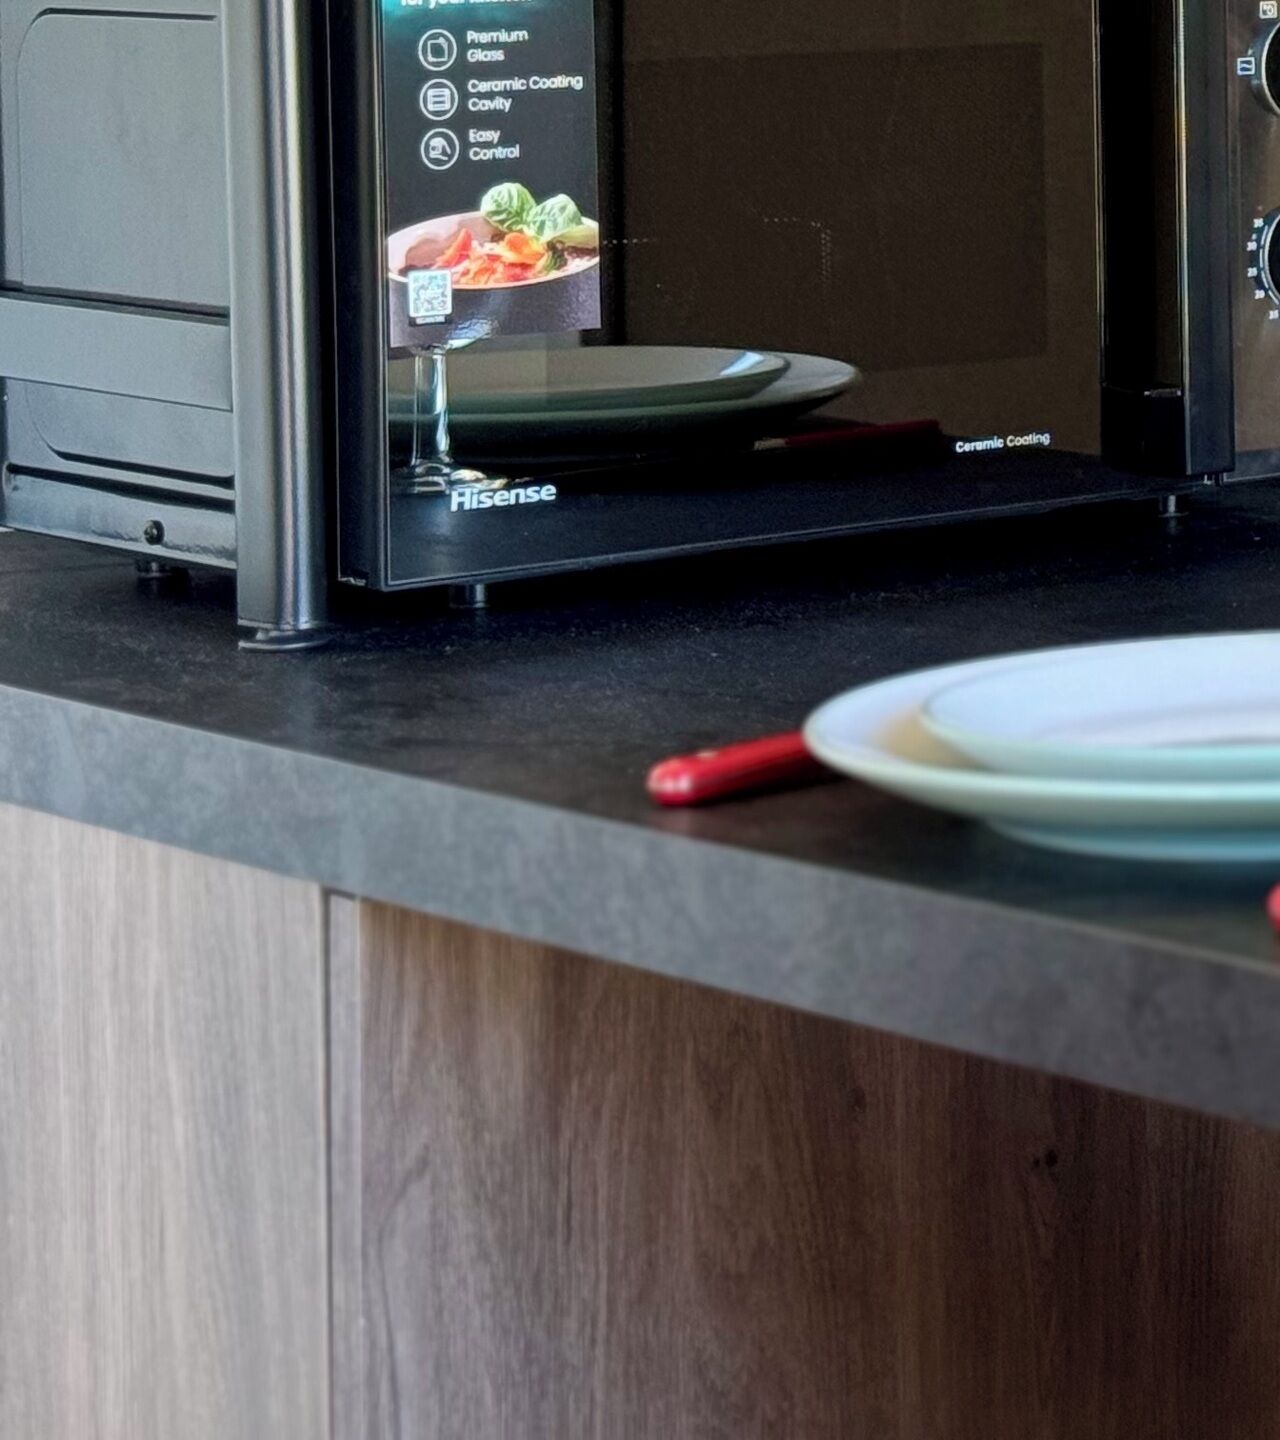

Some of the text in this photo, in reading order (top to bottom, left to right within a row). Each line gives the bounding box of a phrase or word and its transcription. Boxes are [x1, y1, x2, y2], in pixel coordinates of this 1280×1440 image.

[467, 29, 529, 44] Premium
[467, 48, 505, 62] Glass
[467, 74, 584, 93] Ceramic Coating
[468, 96, 512, 113] Cavity
[468, 128, 501, 144] Easy
[469, 143, 520, 161] Control
[955, 432, 1051, 453] Ceramic Coating
[450, 484, 557, 512] Hisense
